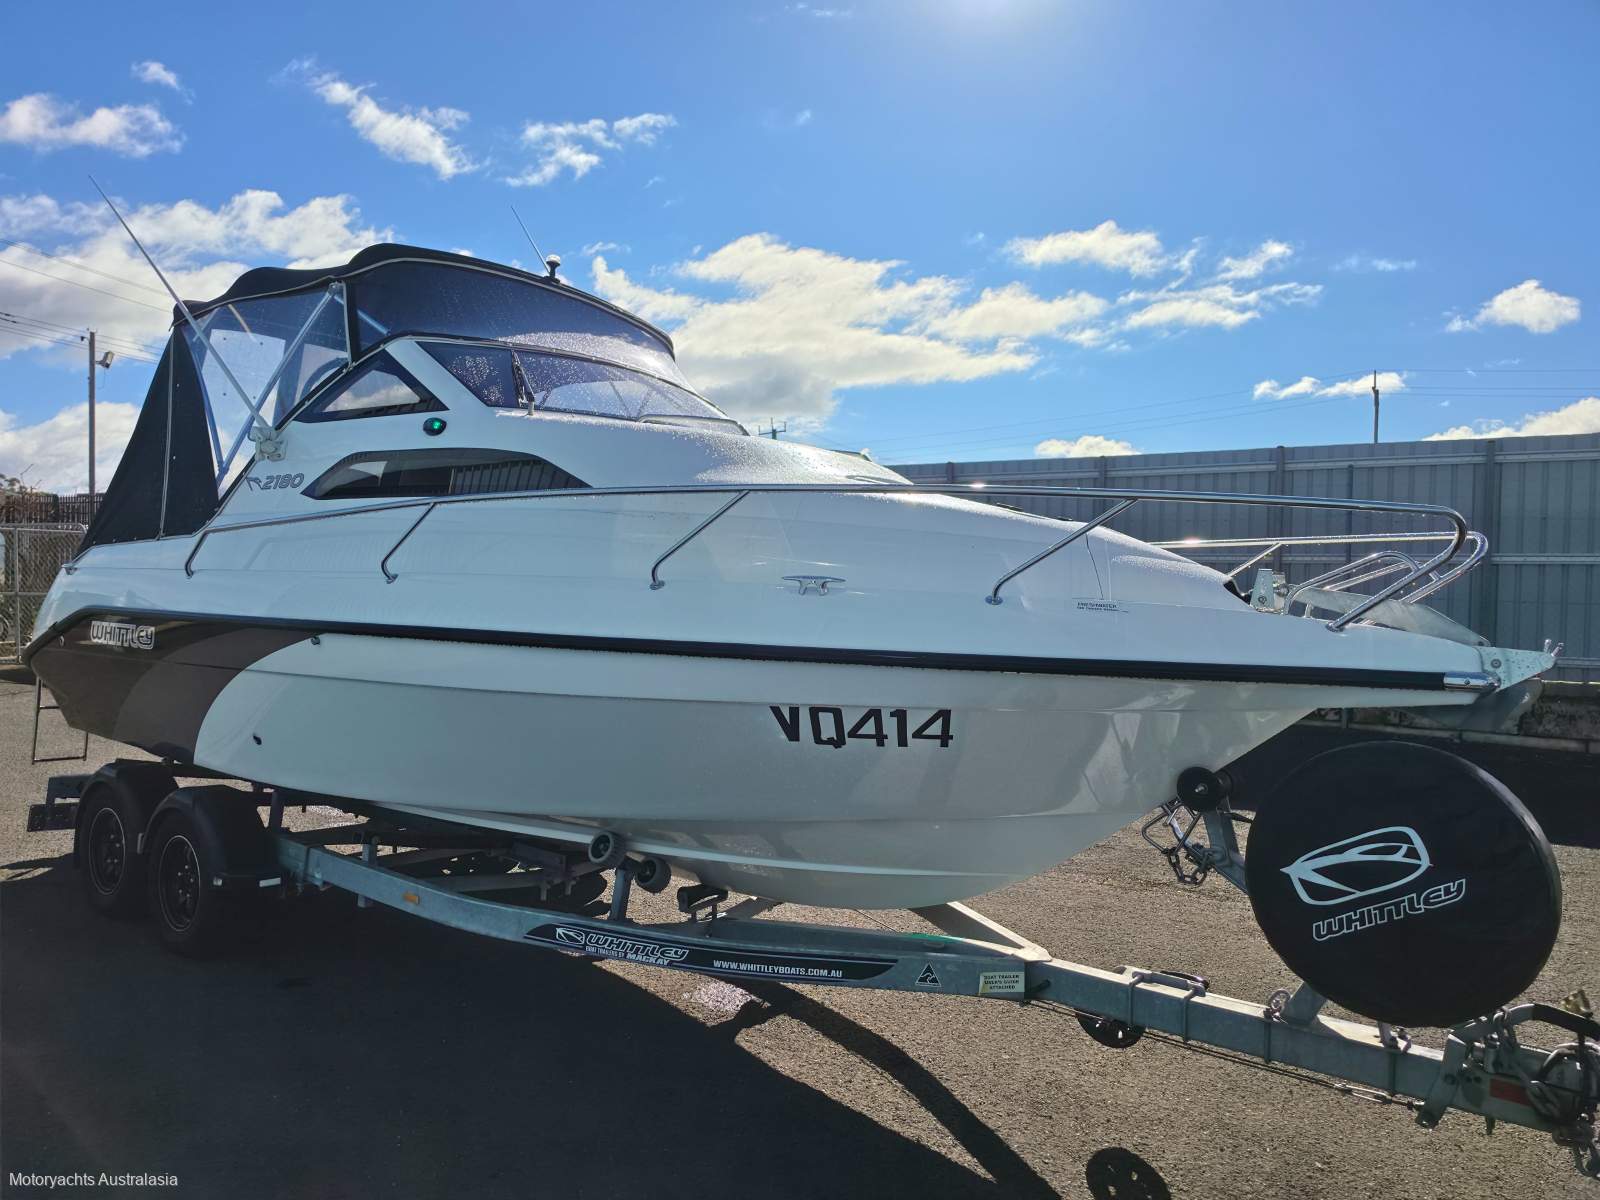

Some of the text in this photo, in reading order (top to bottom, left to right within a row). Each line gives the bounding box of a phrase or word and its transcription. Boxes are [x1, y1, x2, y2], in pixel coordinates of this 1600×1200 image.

[90, 620, 155, 650] WHITTLEY
[769, 704, 954, 749] VQ414
[1312, 878, 1466, 942] WHITTLEY
[586, 933, 689, 961] WHITTLEY
[626, 952, 670, 966] MACKAY
[713, 959, 843, 978] WWW.WHITTLEYBOATS.COM.AU
